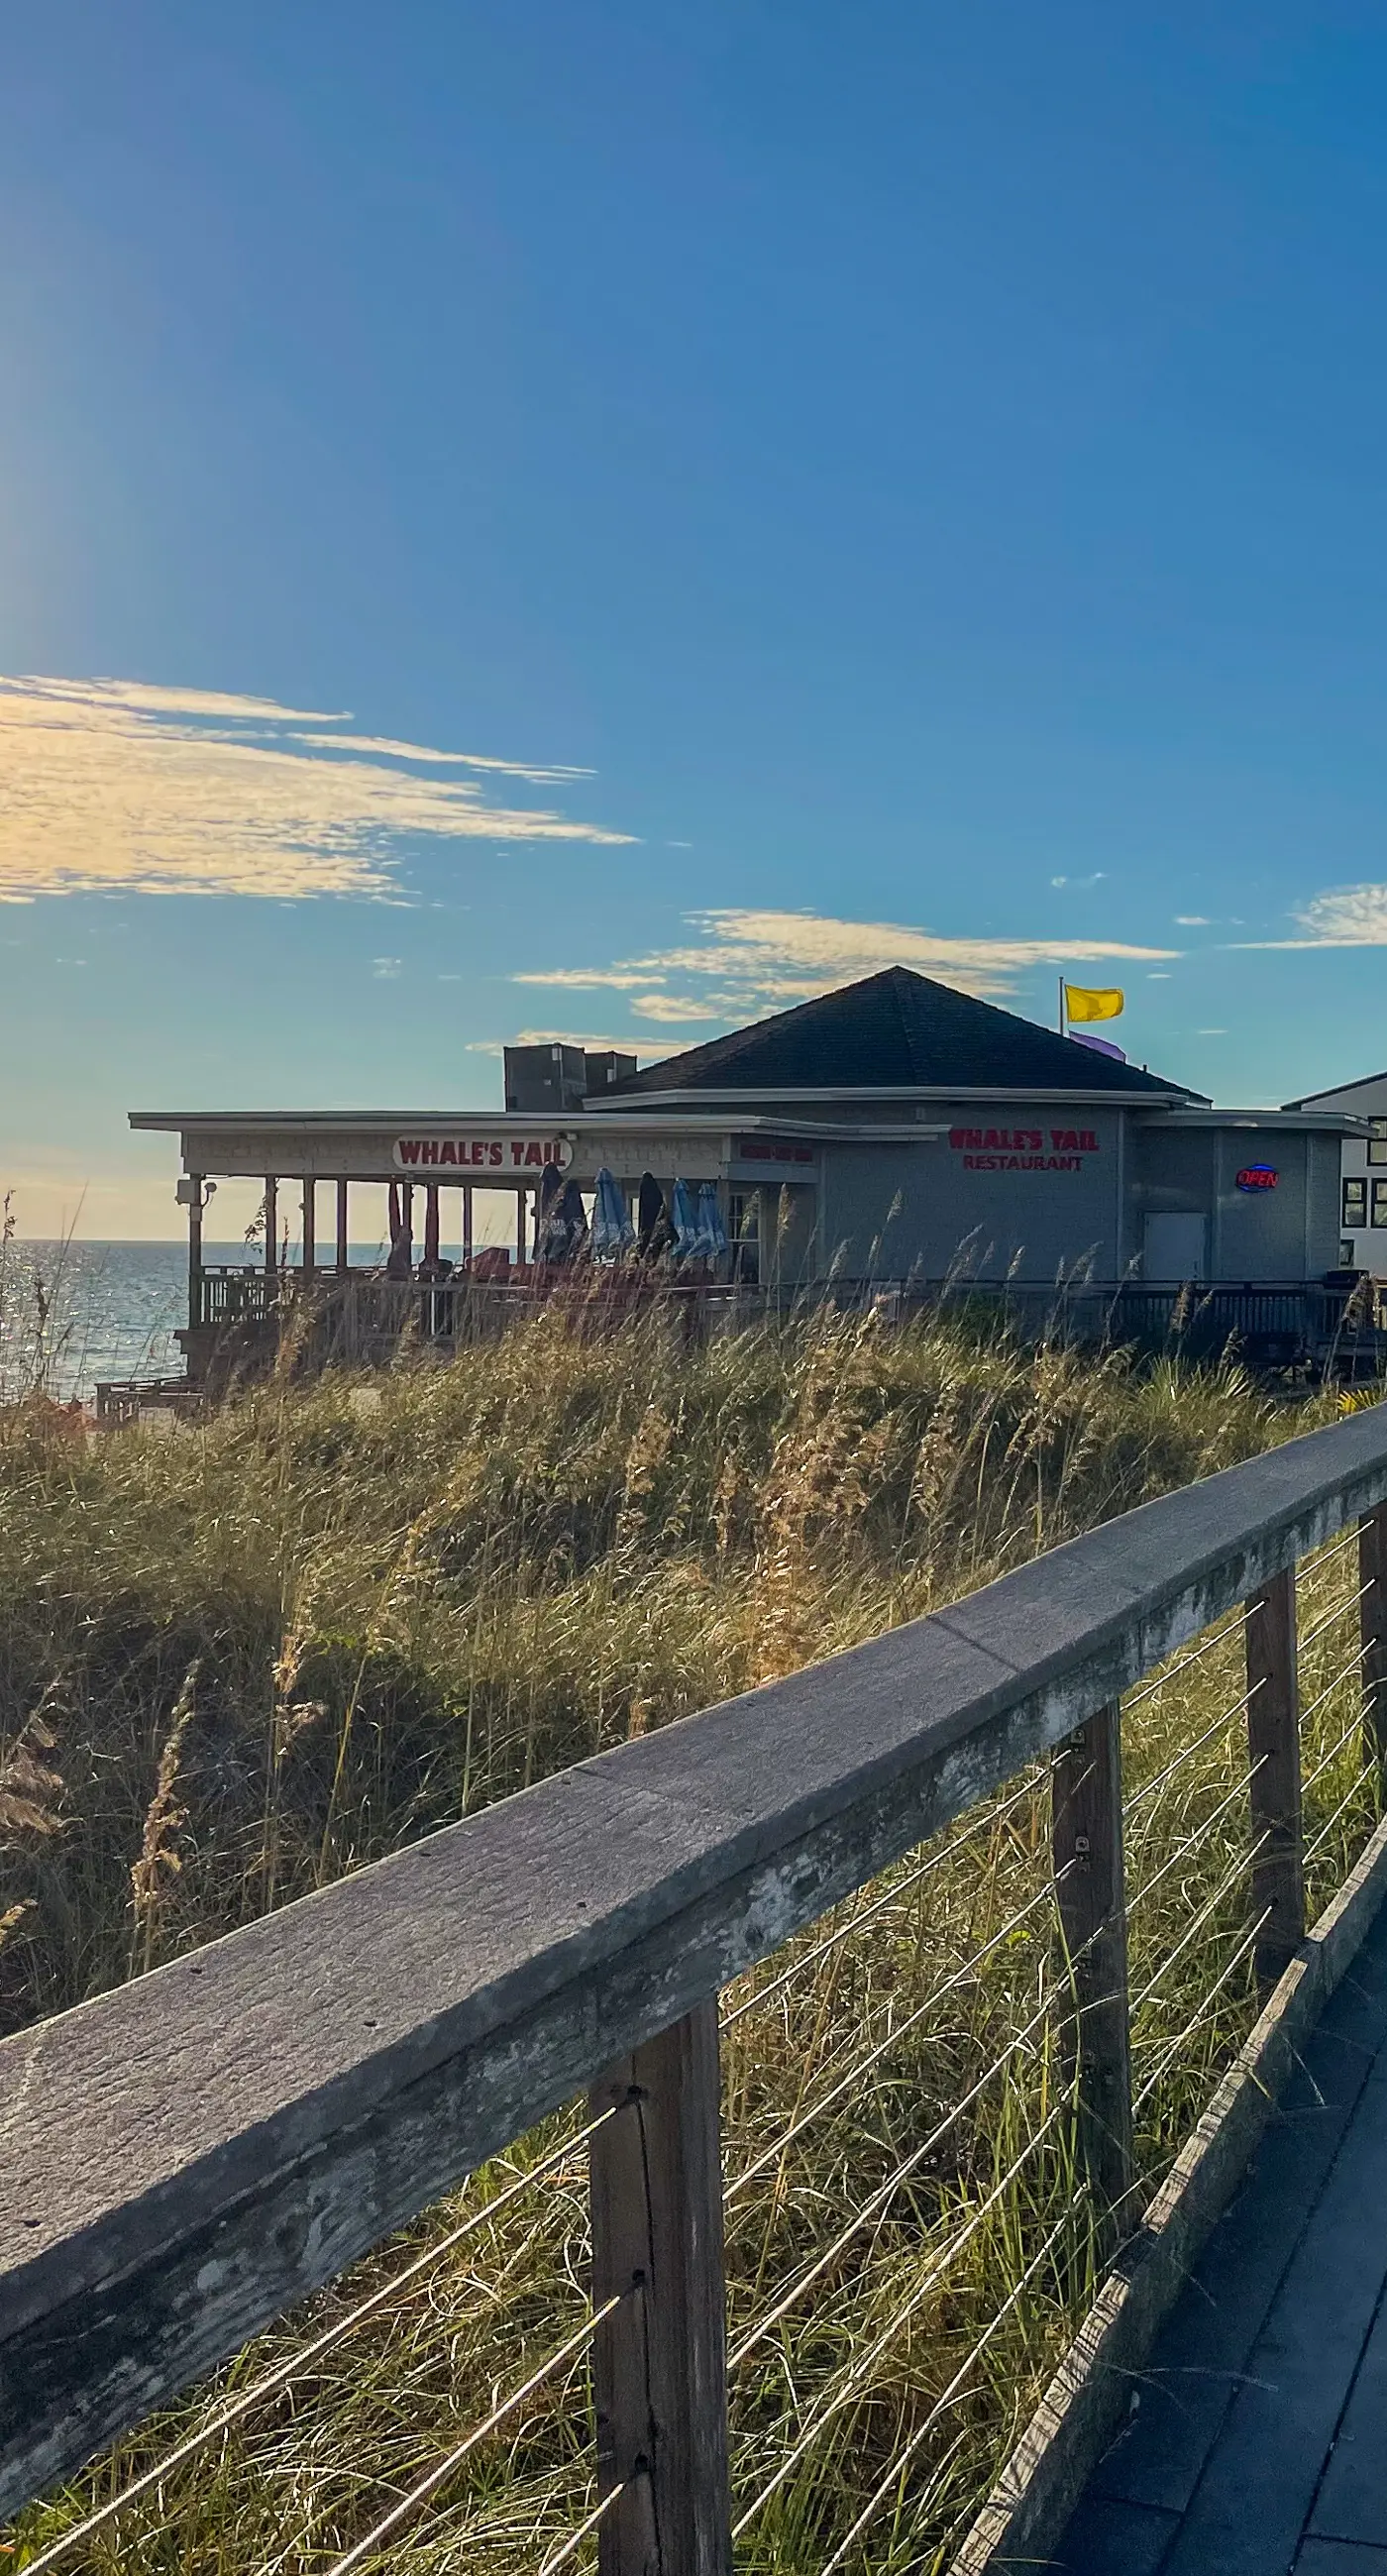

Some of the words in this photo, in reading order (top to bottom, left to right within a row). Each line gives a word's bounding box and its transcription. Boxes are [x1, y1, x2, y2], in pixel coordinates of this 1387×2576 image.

[950, 1128, 1042, 1151] WHALE'S
[1050, 1130, 1100, 1151] TAIL
[398, 1140, 502, 1166] WHALE'S
[511, 1141, 567, 1166] TAIL
[963, 1155, 1083, 1171] RESTAURANT
[1236, 1169, 1279, 1188] OPEN
